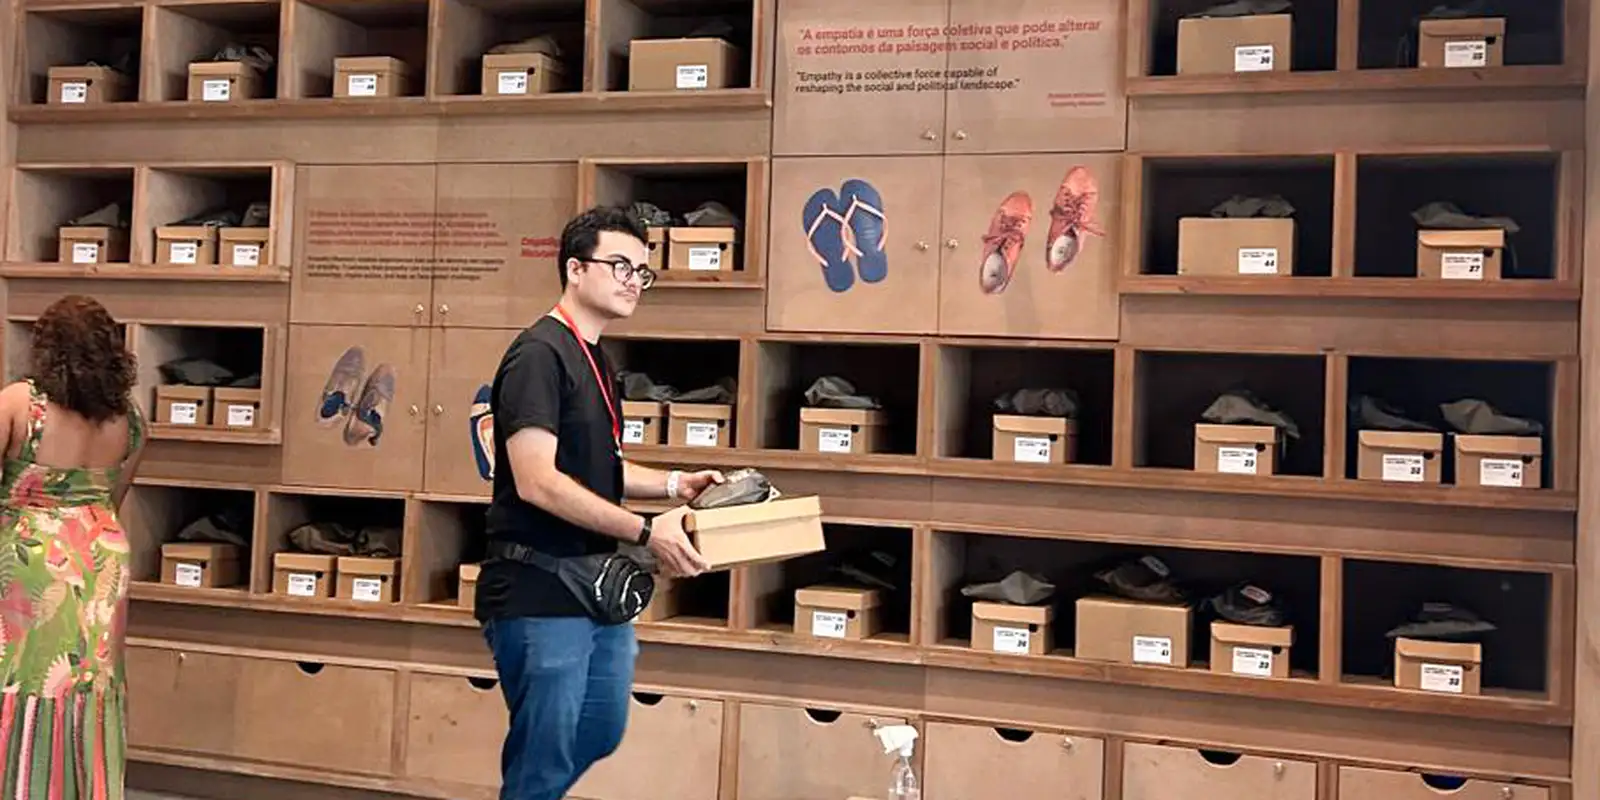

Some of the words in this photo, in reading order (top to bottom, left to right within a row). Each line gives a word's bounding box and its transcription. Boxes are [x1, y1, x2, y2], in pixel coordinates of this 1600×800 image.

[815, 27, 863, 41] empatia
[877, 28, 904, 39] uma
[907, 24, 940, 39] força
[942, 21, 993, 37] coletiva
[995, 24, 1020, 37] que
[1022, 21, 1056, 35] pode
[1058, 19, 1101, 33] alterar
[796, 45, 811, 55] os
[815, 42, 875, 55] contornos
[878, 41, 895, 53] da
[896, 40, 957, 54] paisagem
[960, 37, 998, 50] social
[1000, 39, 1009, 50] e
[844, 70, 854, 81] is
[855, 72, 863, 80] a
[864, 69, 912, 80] collective
[915, 68, 941, 79] force
[943, 65, 985, 79] capable
[986, 65, 999, 77] of
[795, 83, 844, 94] reshaping
[846, 82, 862, 92] the
[864, 82, 894, 92] social
[896, 81, 915, 91] and
[917, 79, 958, 92] political
